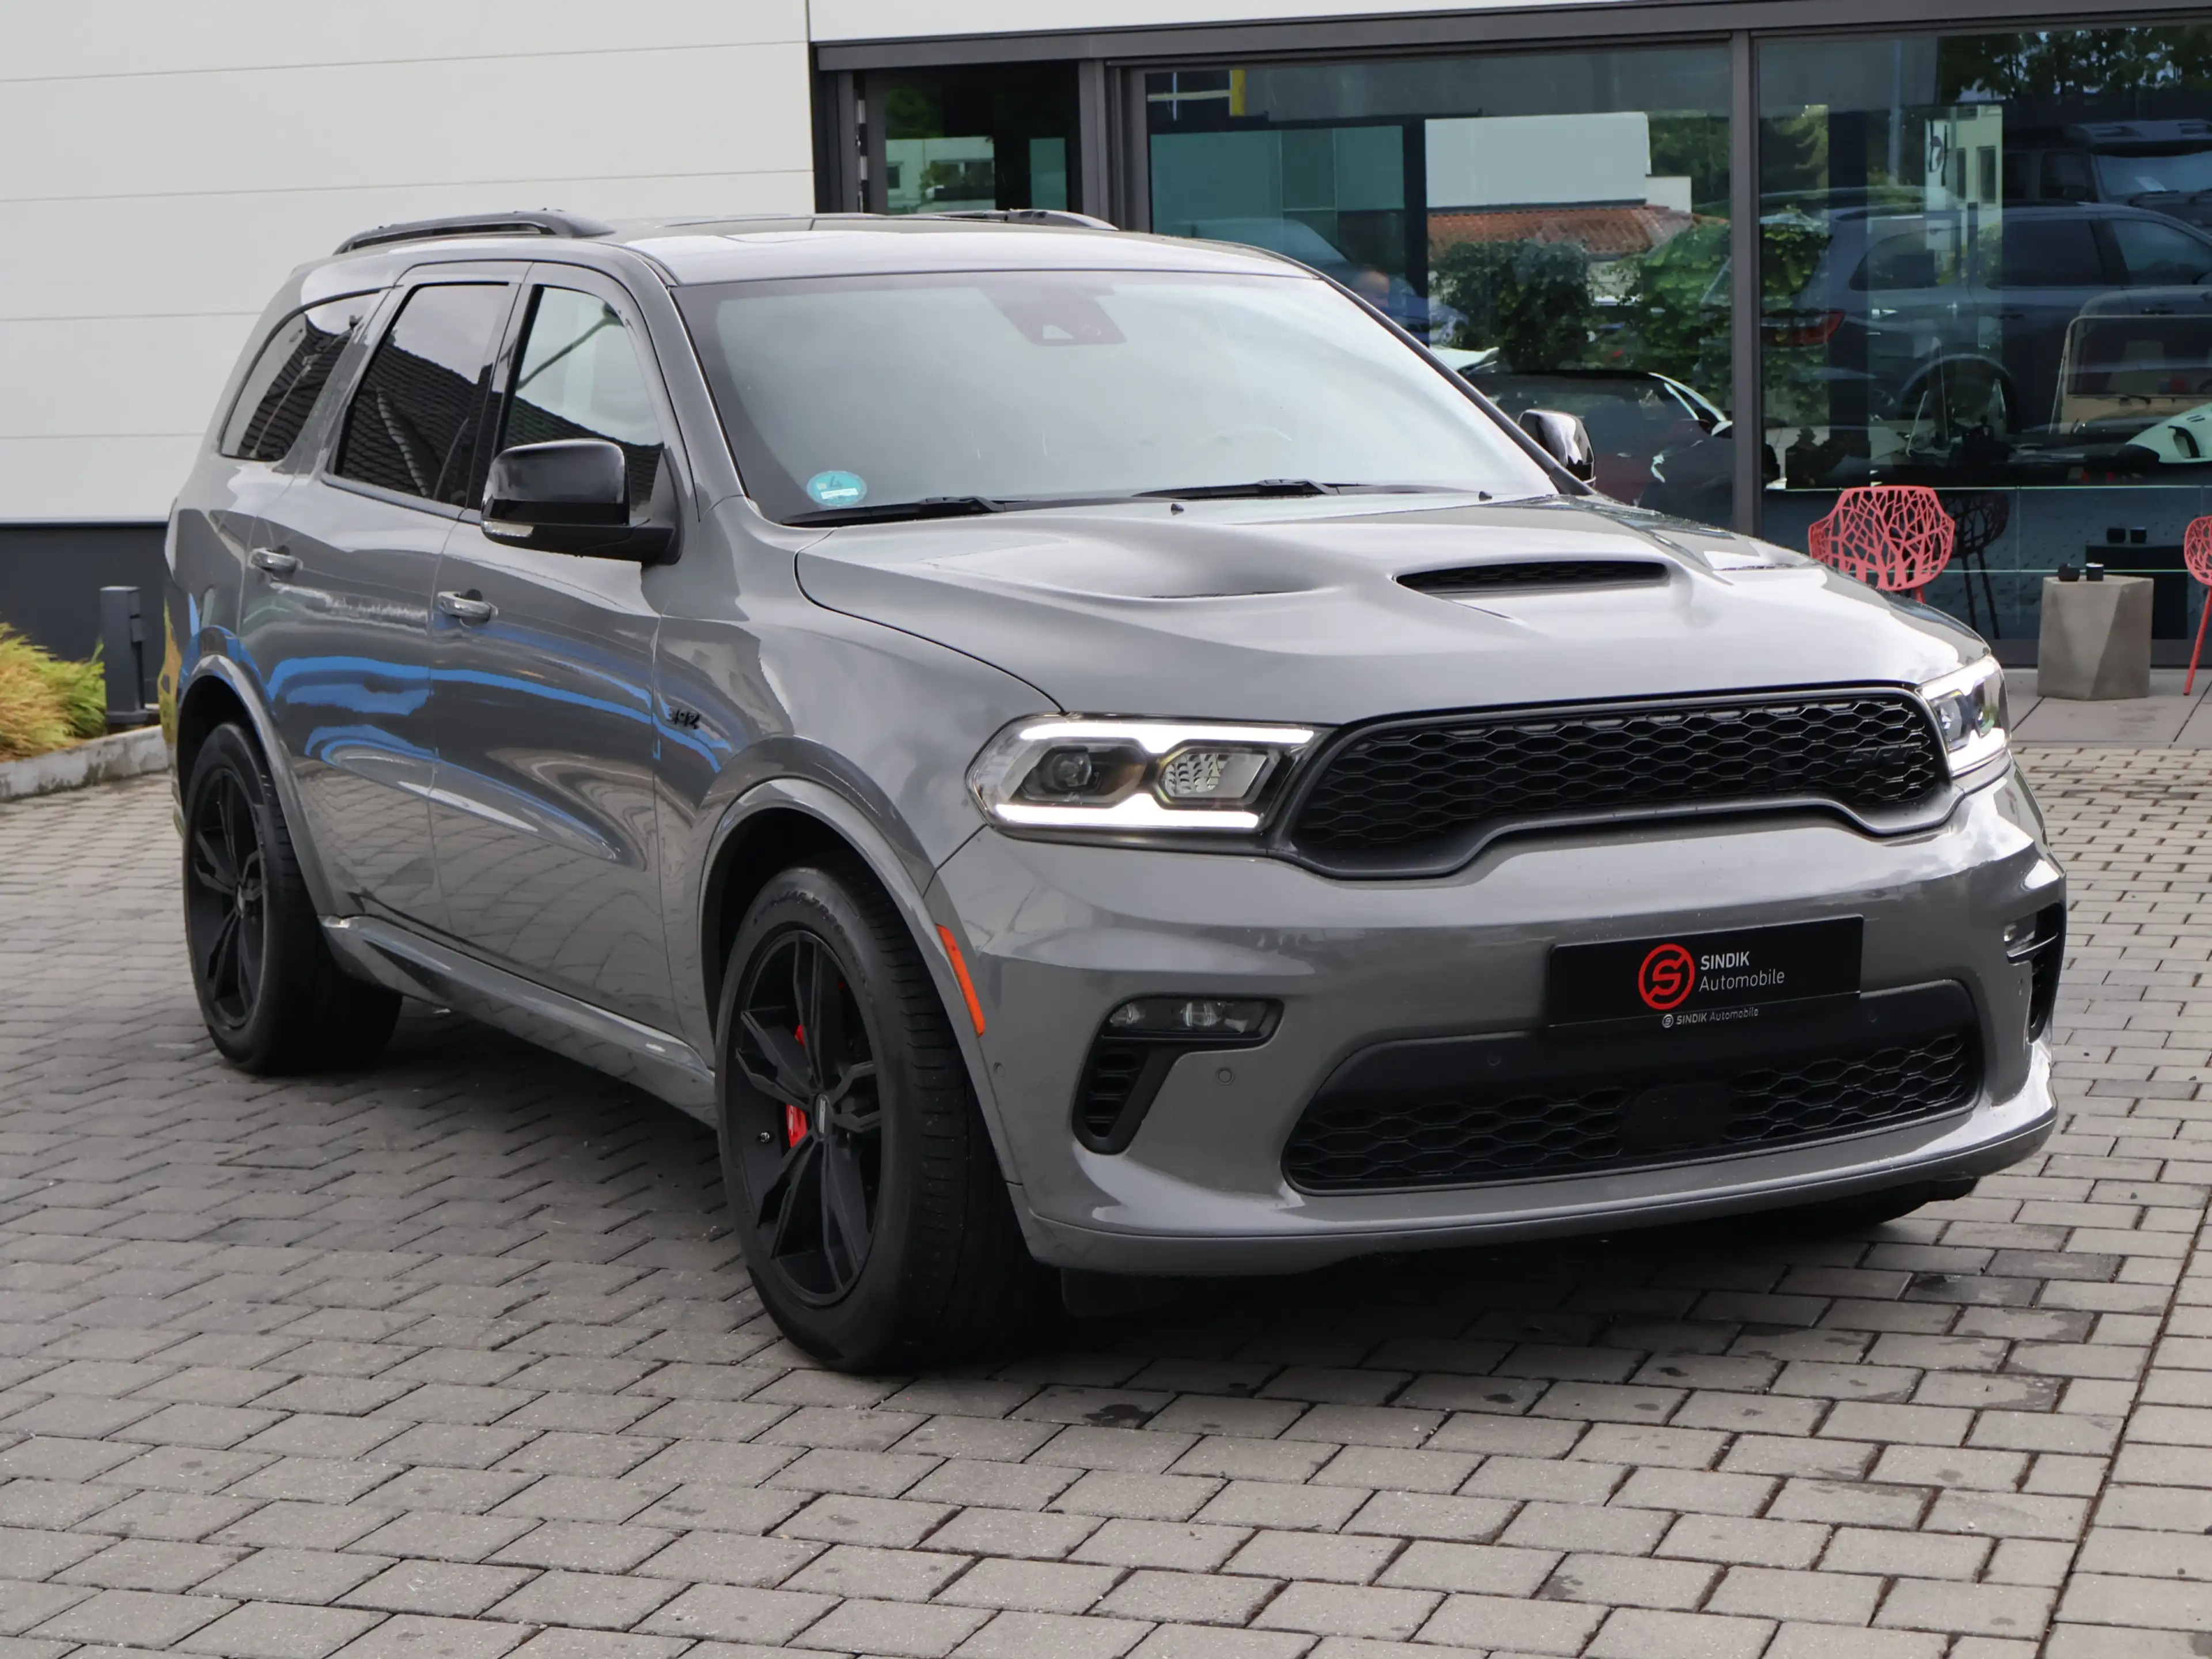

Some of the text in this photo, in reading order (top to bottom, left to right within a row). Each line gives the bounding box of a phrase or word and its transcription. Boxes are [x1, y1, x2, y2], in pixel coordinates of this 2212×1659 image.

[1700, 951, 1750, 971] SINDIK
[1699, 968, 1785, 992] Automobile
[1676, 1007, 1759, 1025] SINDIK Automobile
